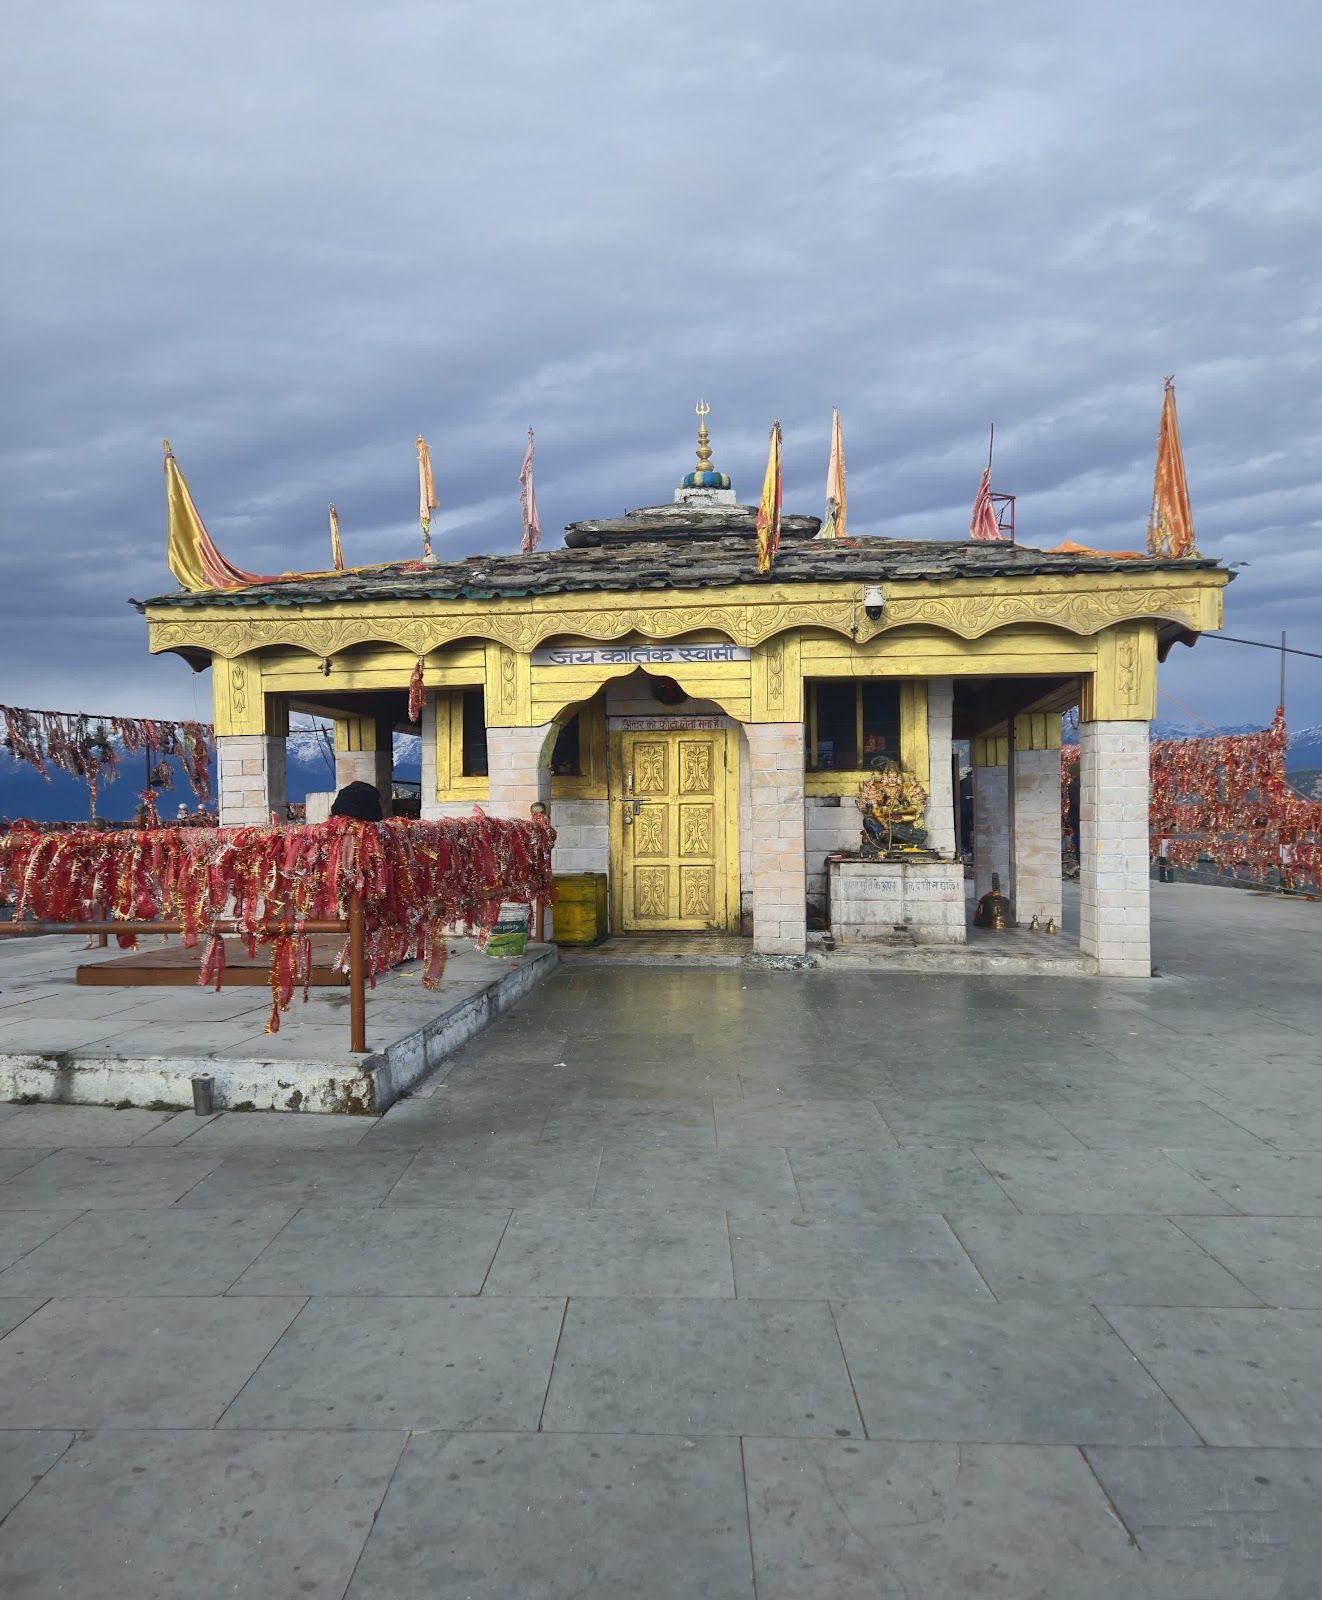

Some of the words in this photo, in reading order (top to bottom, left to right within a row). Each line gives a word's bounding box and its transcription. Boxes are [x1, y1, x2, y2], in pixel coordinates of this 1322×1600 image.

[549, 651, 597, 664] जय
[599, 646, 675, 663] कार्तिक
[678, 643, 738, 662] स्वामी
